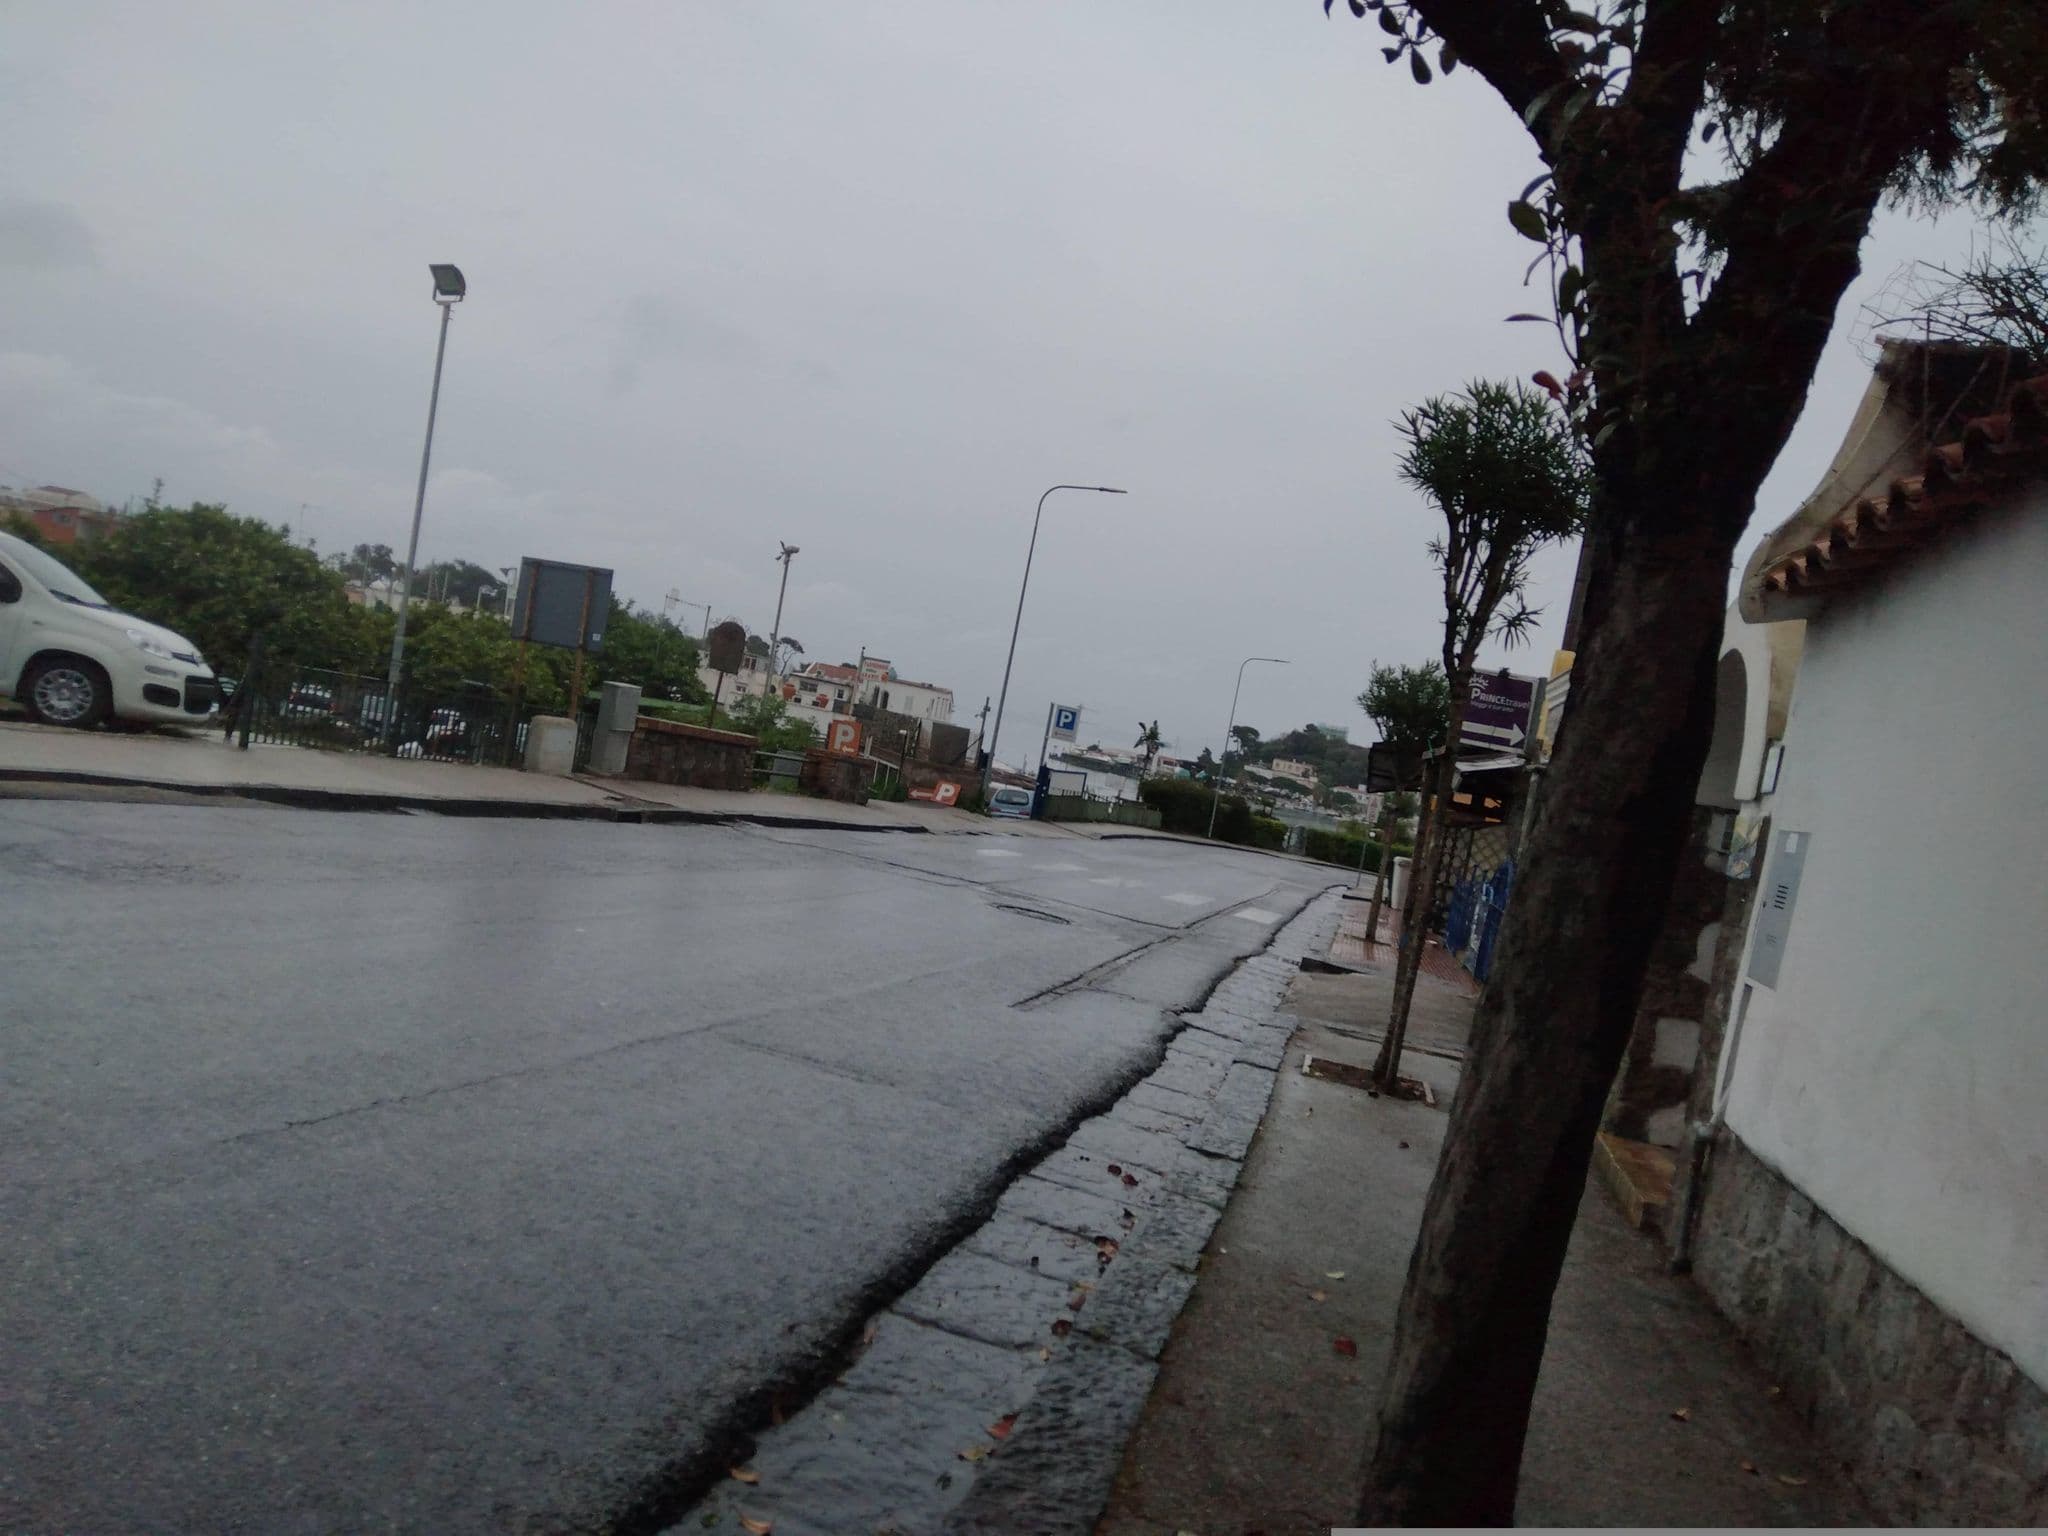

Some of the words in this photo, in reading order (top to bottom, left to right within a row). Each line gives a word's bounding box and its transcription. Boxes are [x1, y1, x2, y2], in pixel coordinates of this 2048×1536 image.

[1059, 711, 1073, 726] P
[833, 724, 855, 749] P
[936, 784, 955, 801] P
